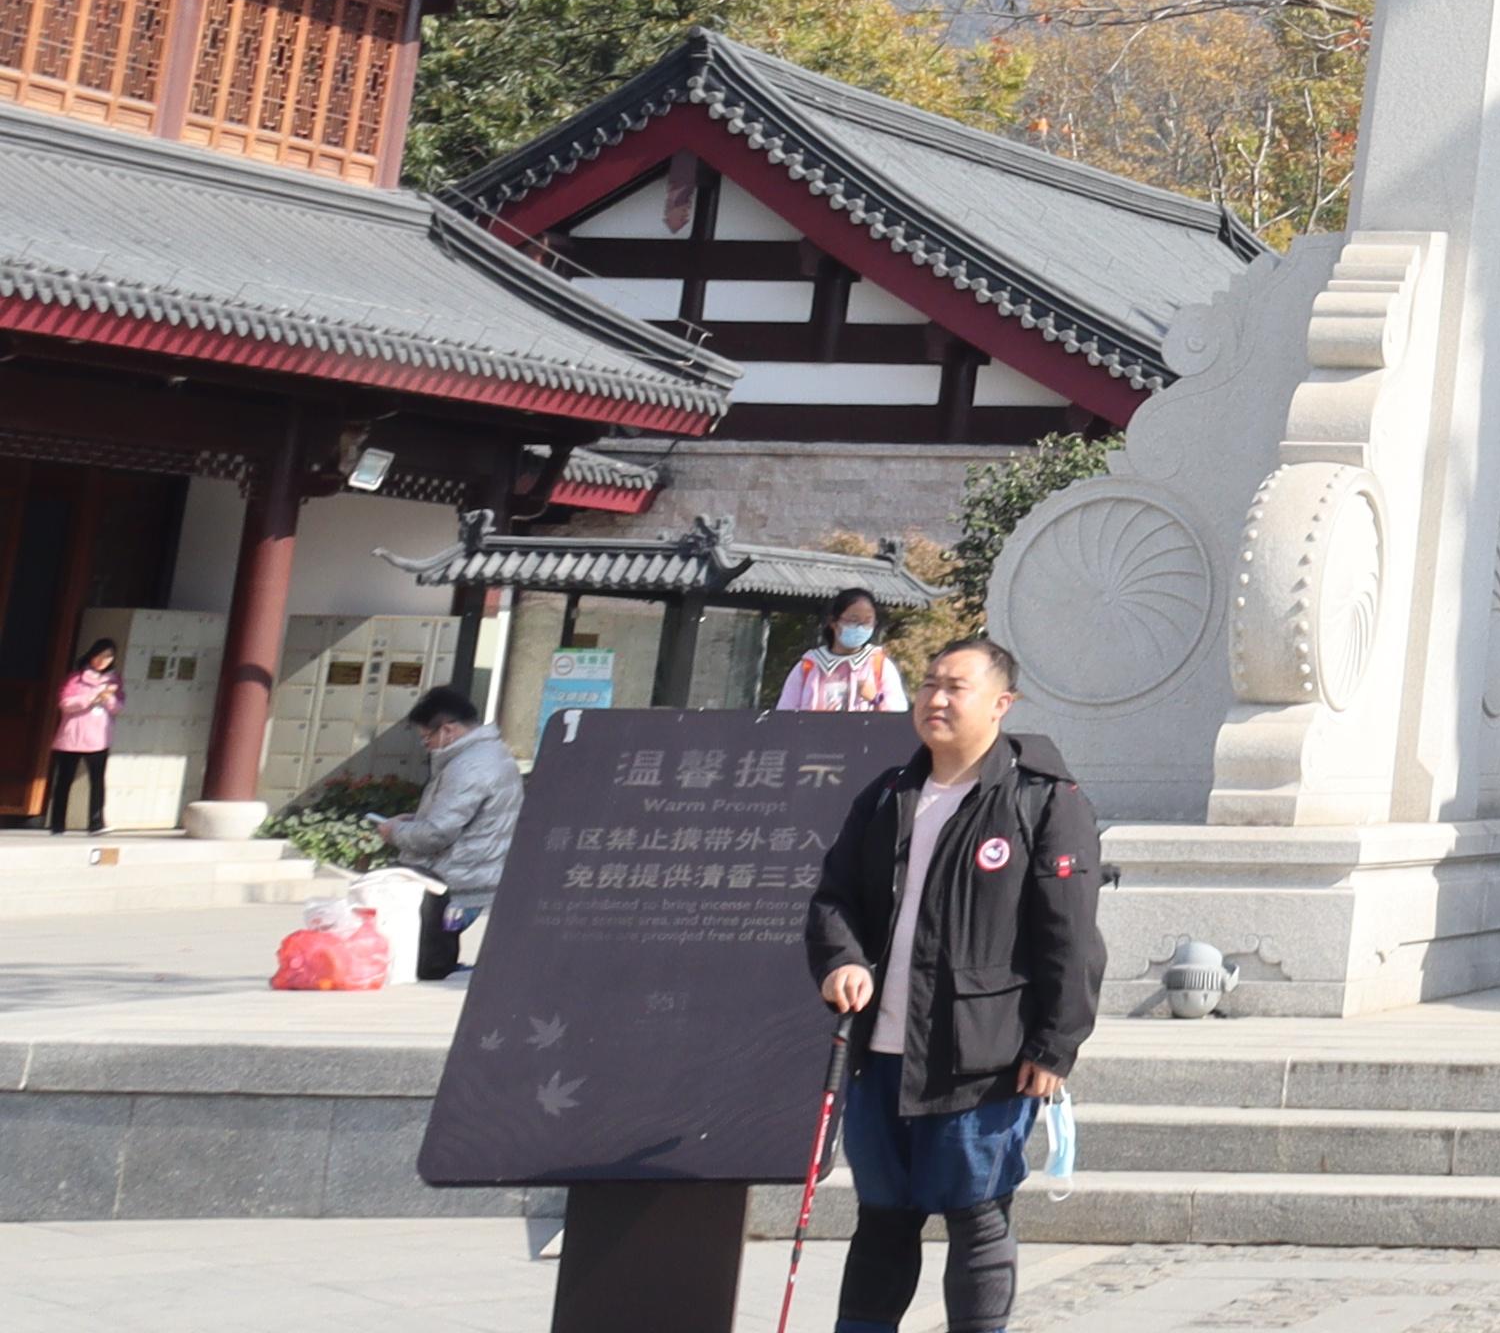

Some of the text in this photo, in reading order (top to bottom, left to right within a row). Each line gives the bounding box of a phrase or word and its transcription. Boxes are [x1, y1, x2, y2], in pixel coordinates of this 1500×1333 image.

[614, 748, 847, 789] 温馨提示
[644, 797, 788, 816] Warm Prompt
[544, 826, 840, 853] 景区禁止携带外香入
